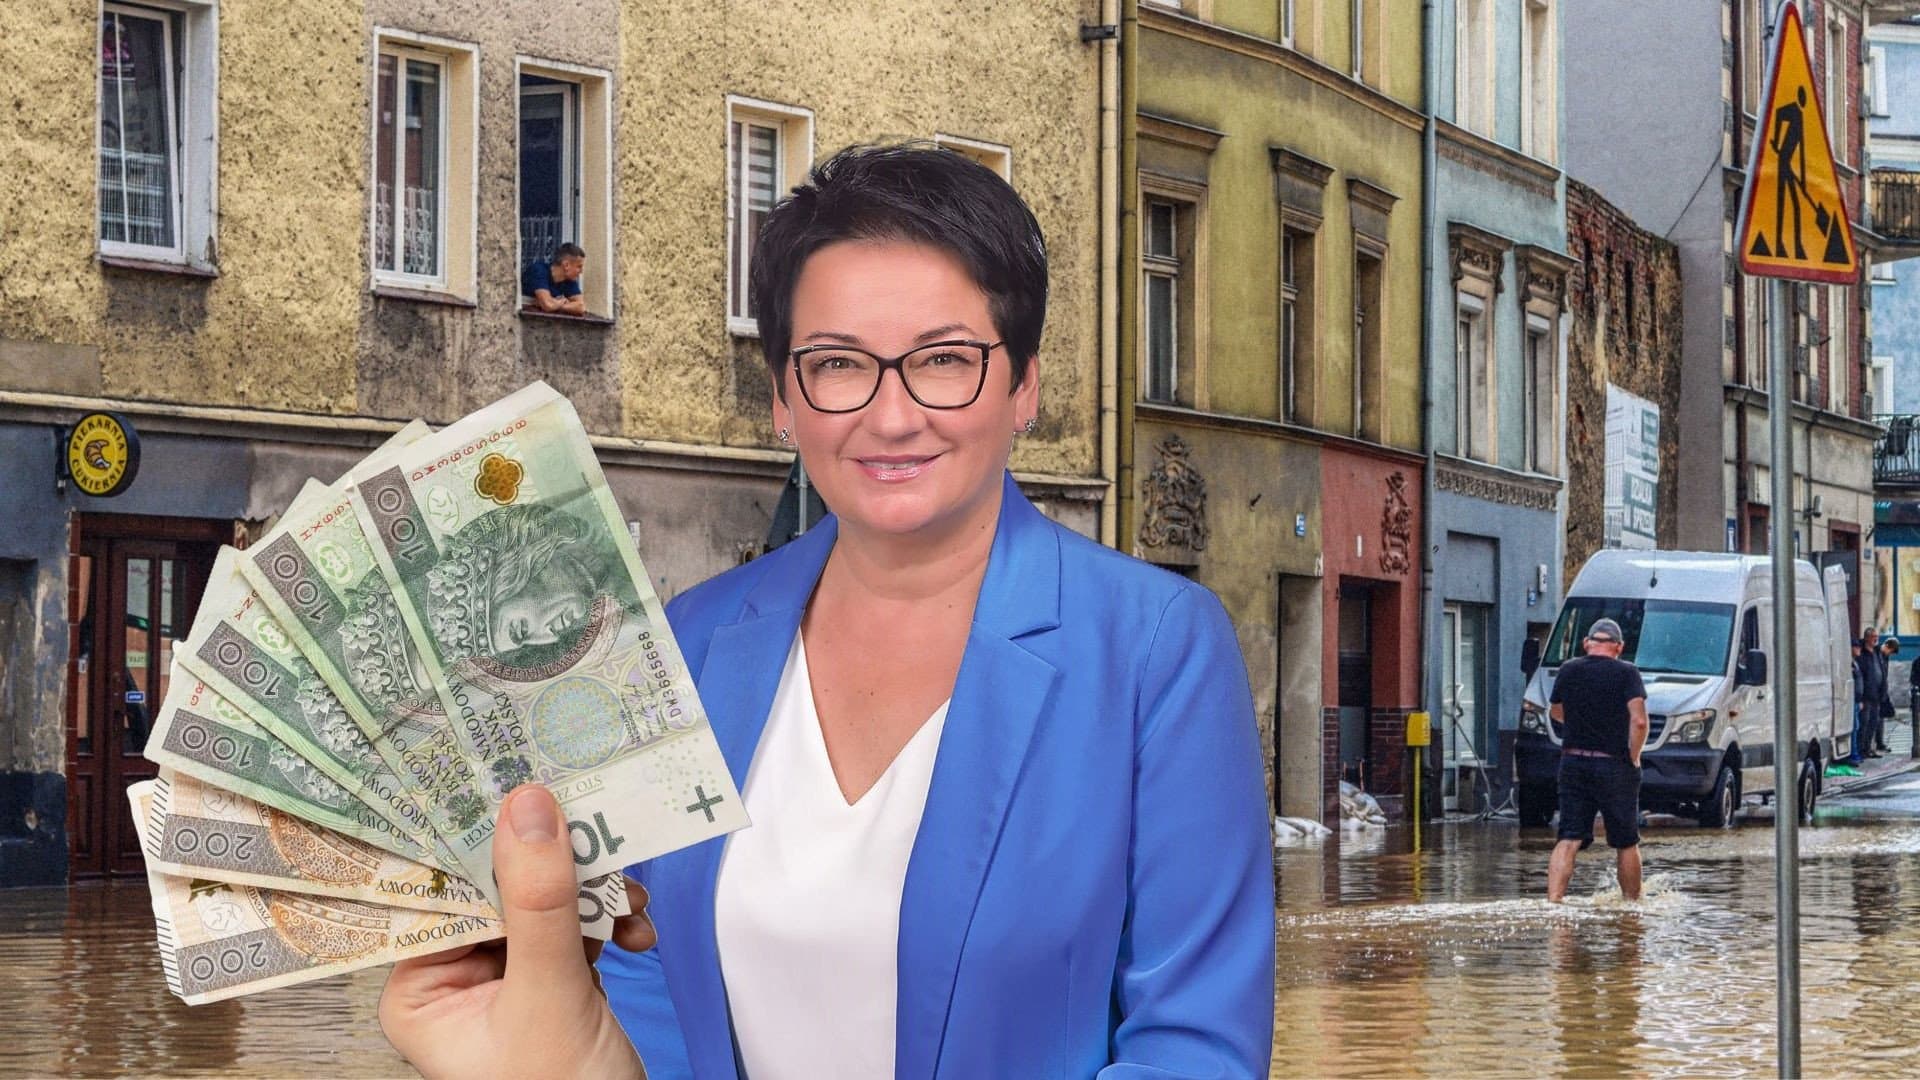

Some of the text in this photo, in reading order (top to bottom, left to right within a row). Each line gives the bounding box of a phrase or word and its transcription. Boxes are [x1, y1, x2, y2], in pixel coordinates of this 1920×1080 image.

[72, 418, 125, 451] PIEKARNIA
[71, 458, 125, 490] CUKIERNIA
[377, 487, 425, 561] 100
[274, 553, 331, 620] 100
[218, 641, 282, 697] 100
[443, 671, 494, 762] NARODOWY
[481, 708, 511, 755] BANK
[493, 690, 528, 748] POLSKI
[181, 724, 252, 768] 100
[381, 719, 441, 805] NARODOWY
[430, 729, 475, 783] POLSKI
[425, 748, 460, 793] BANK
[576, 776, 604, 792] STO
[174, 828, 254, 861] 200
[375, 879, 472, 904] NARODOWY
[394, 917, 489, 949] NARODOWY
[190, 942, 267, 981] 200
